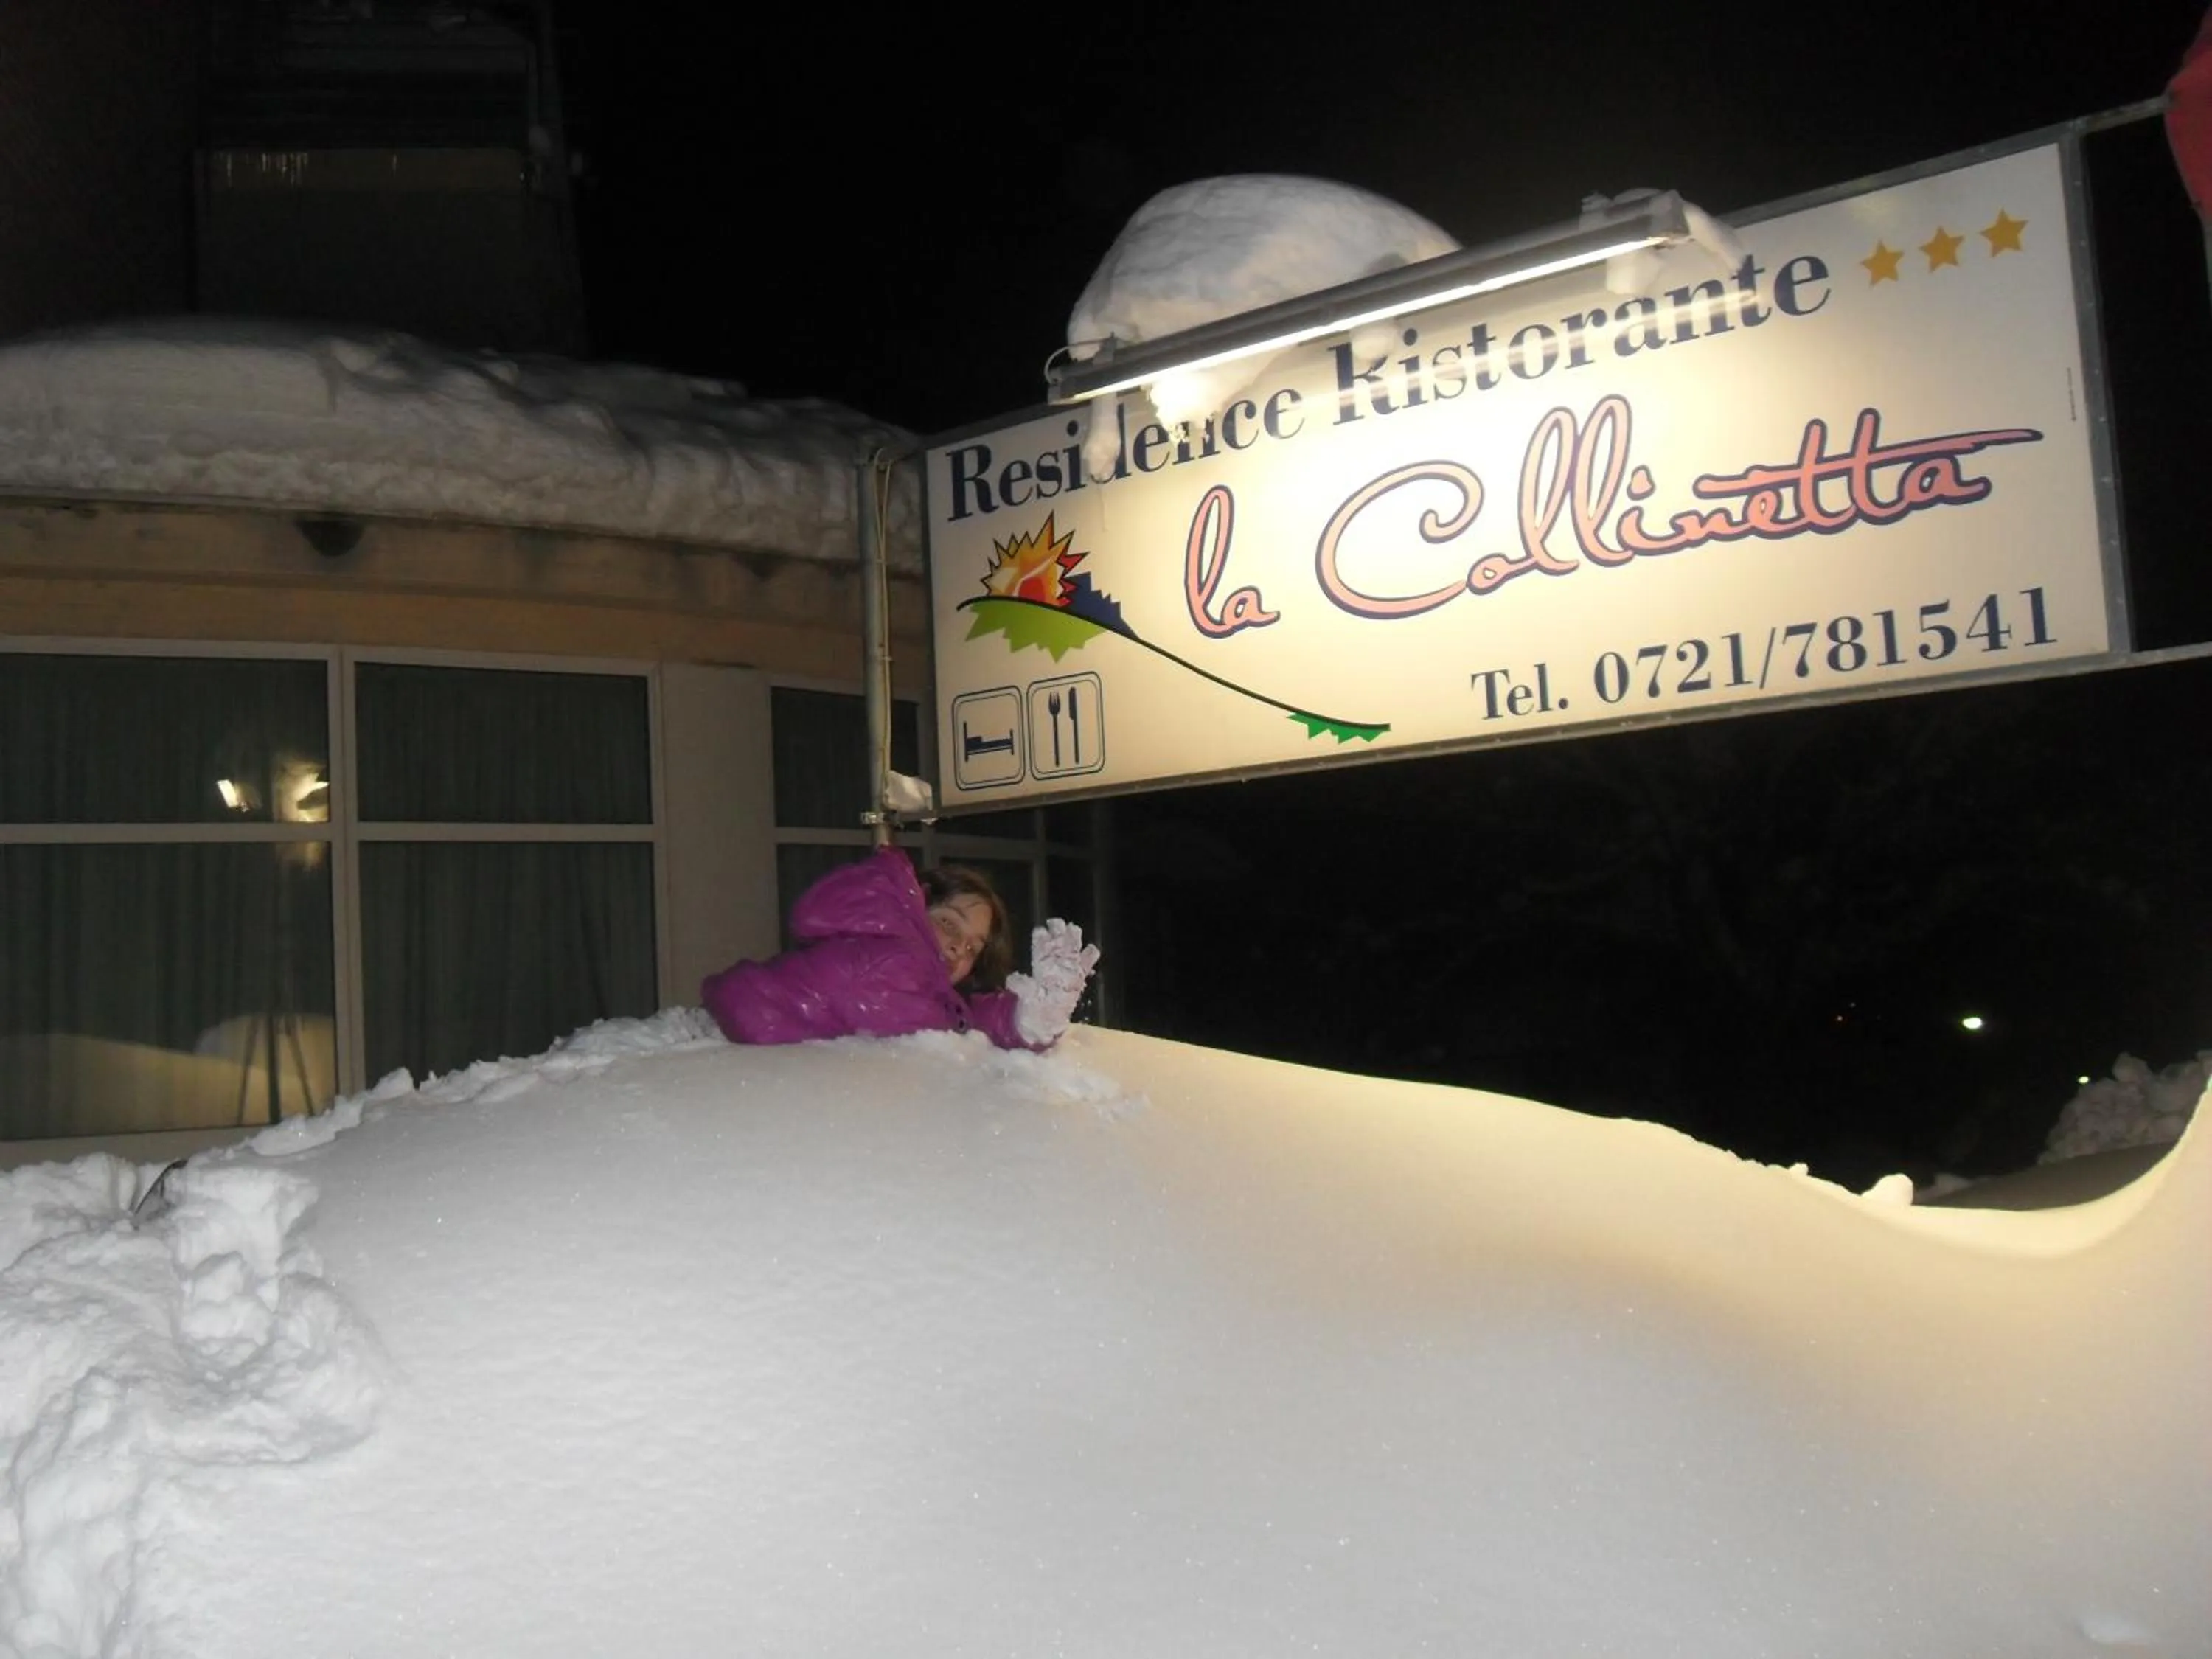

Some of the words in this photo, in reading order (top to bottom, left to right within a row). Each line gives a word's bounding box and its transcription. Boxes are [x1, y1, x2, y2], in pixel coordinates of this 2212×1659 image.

[1326, 253, 1832, 425] Ristorante
[1184, 484, 1281, 639] la
[1315, 394, 2044, 619] Collinetta
[1471, 662, 1570, 720] Tel.
[1593, 586, 2058, 705] 0721/781541
